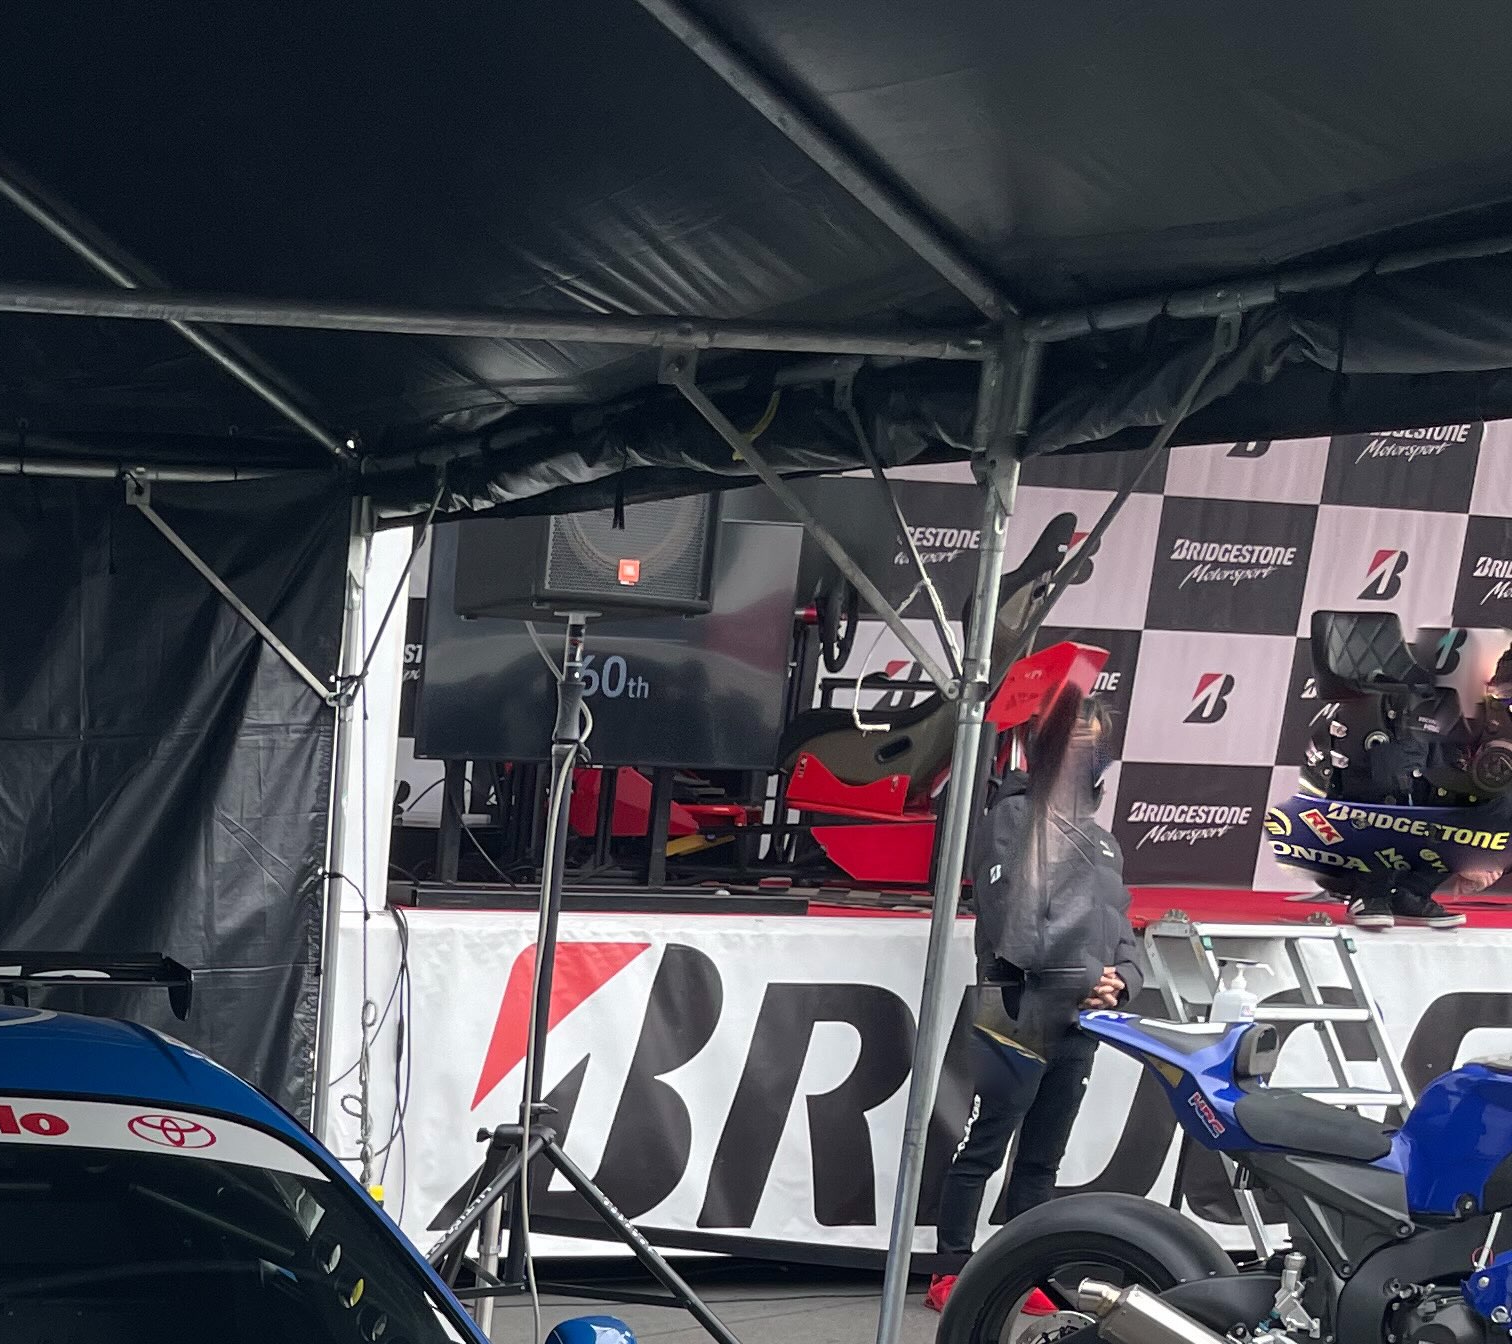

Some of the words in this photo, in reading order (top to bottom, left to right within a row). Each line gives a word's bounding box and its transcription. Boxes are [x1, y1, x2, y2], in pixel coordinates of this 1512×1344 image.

[1355, 438, 1454, 464] Motorsport
[1170, 538, 1297, 566] BRIDGESTONE
[1178, 563, 1278, 590] Motorsport
[1127, 801, 1252, 825] BRIDGESTONE
[1326, 802, 1510, 850] BRIDGETONE
[1135, 824, 1234, 850] Motorsport
[1268, 840, 1372, 873] ONDA
